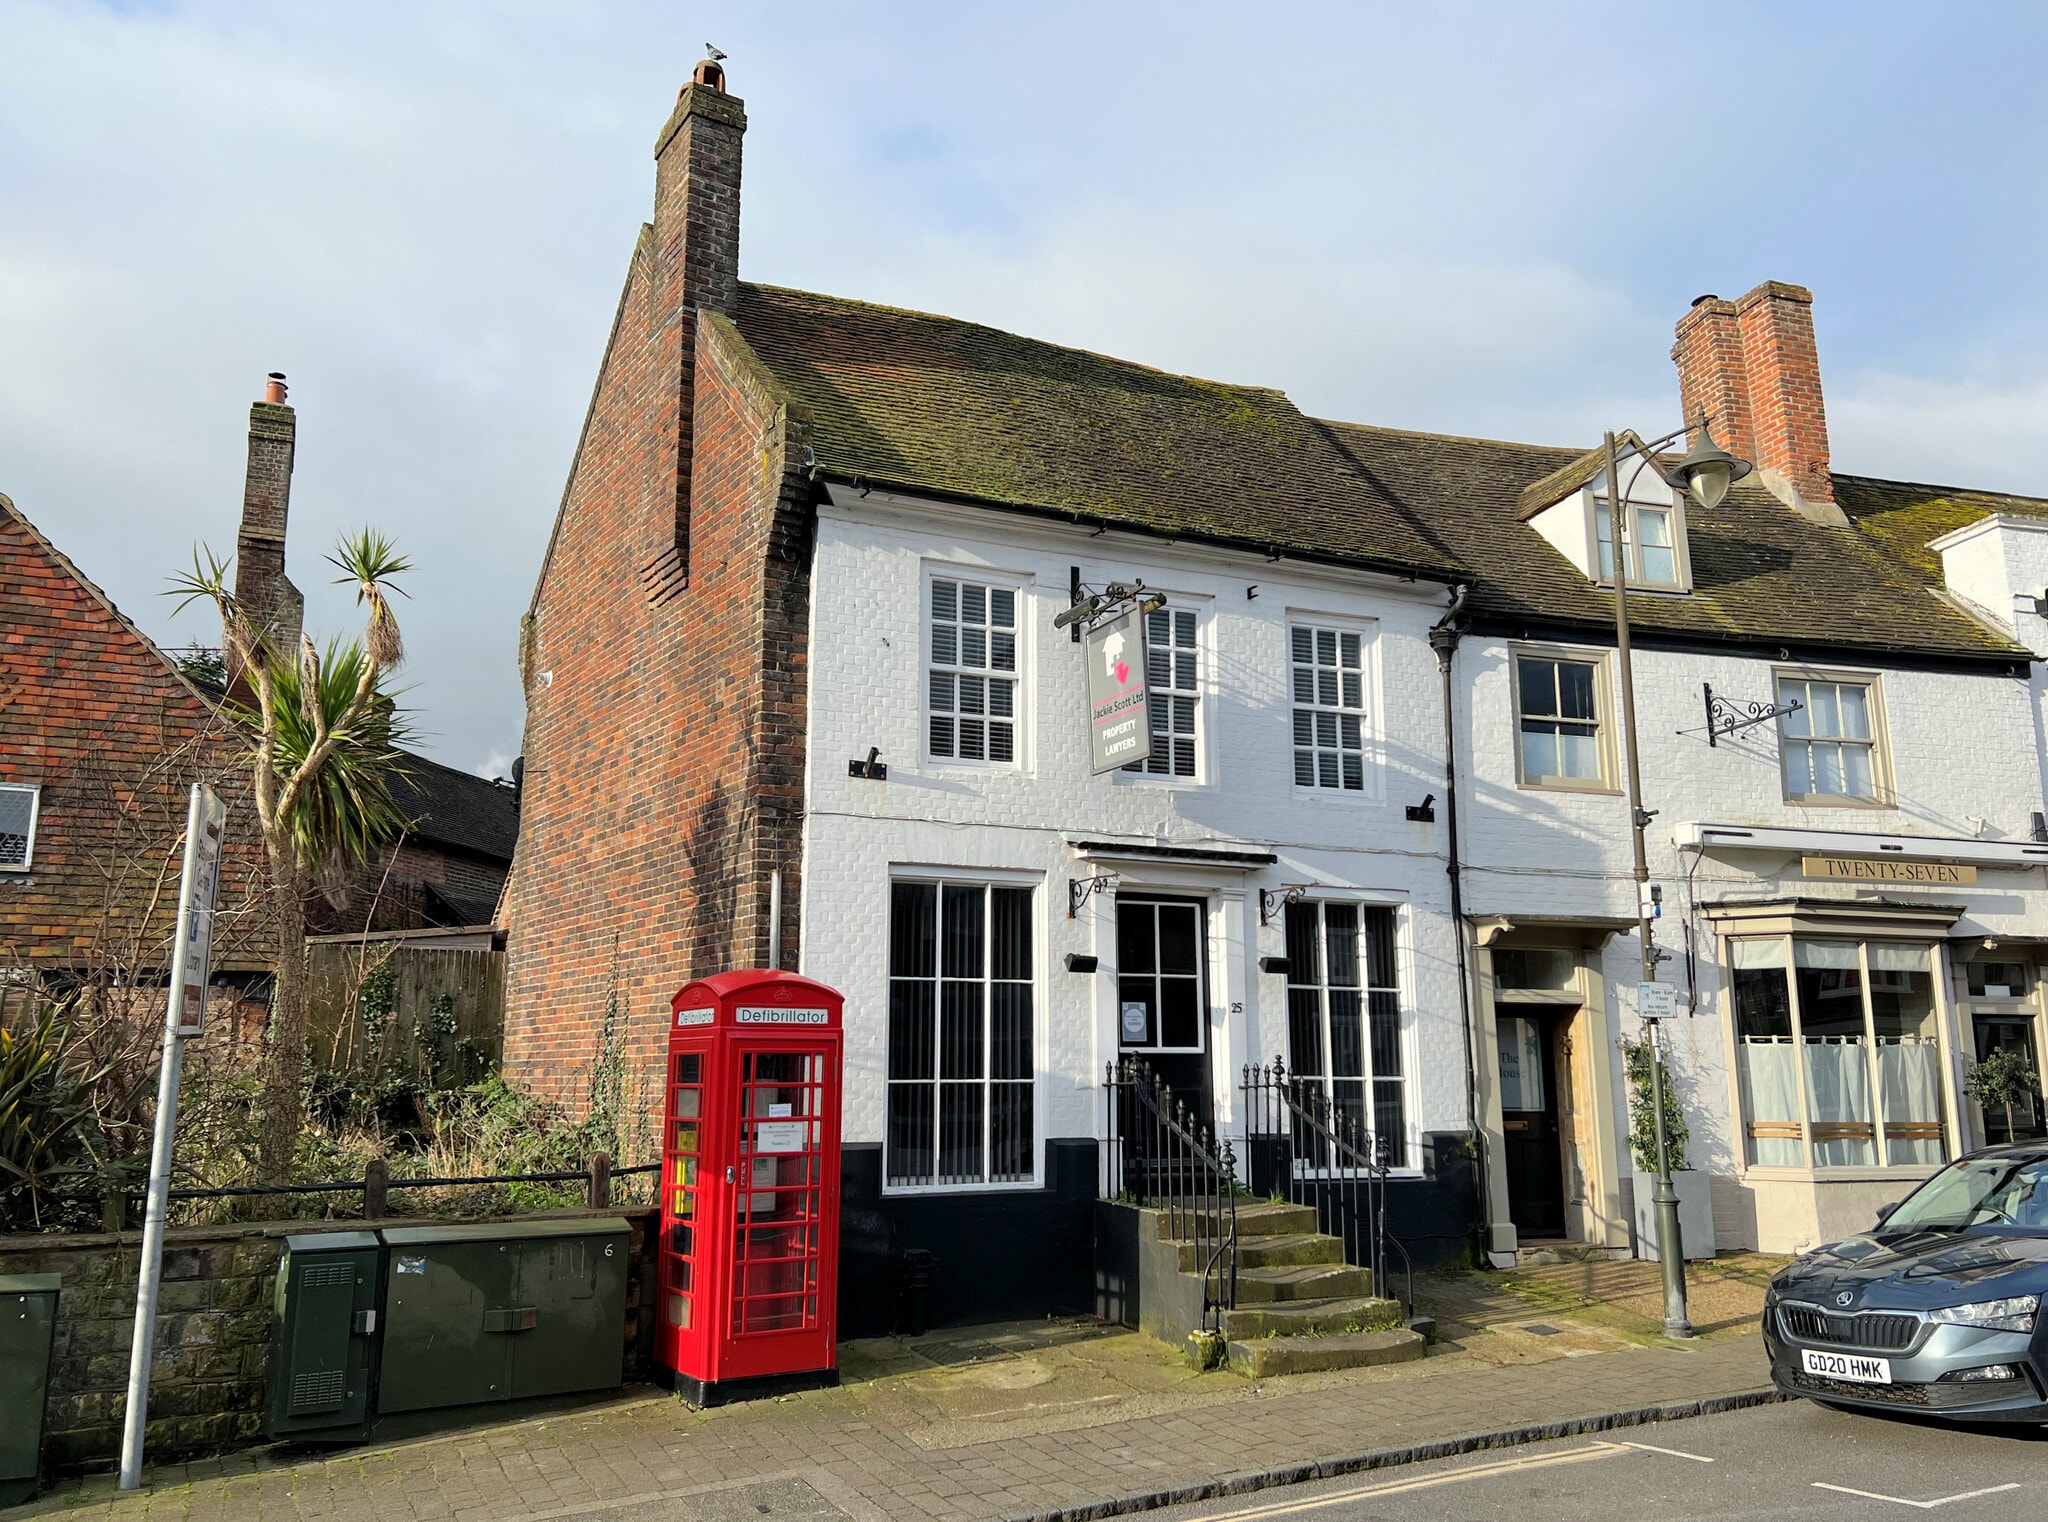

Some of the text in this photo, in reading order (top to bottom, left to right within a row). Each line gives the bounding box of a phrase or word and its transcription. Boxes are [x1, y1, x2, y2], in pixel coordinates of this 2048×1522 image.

[1093, 690, 1144, 720] Jackie Scott Ltd
[1102, 718, 1136, 740] PROPERTY
[1105, 736, 1136, 757] LAWYERS
[1825, 860, 1960, 882] TWENTY-SEVEN
[742, 1009, 825, 1023] Defibrillator
[1231, 1002, 1243, 1013] 25
[1500, 1052, 1519, 1064] The
[604, 1243, 613, 1256] 6
[1808, 1354, 1883, 1379] GD20 HMK
